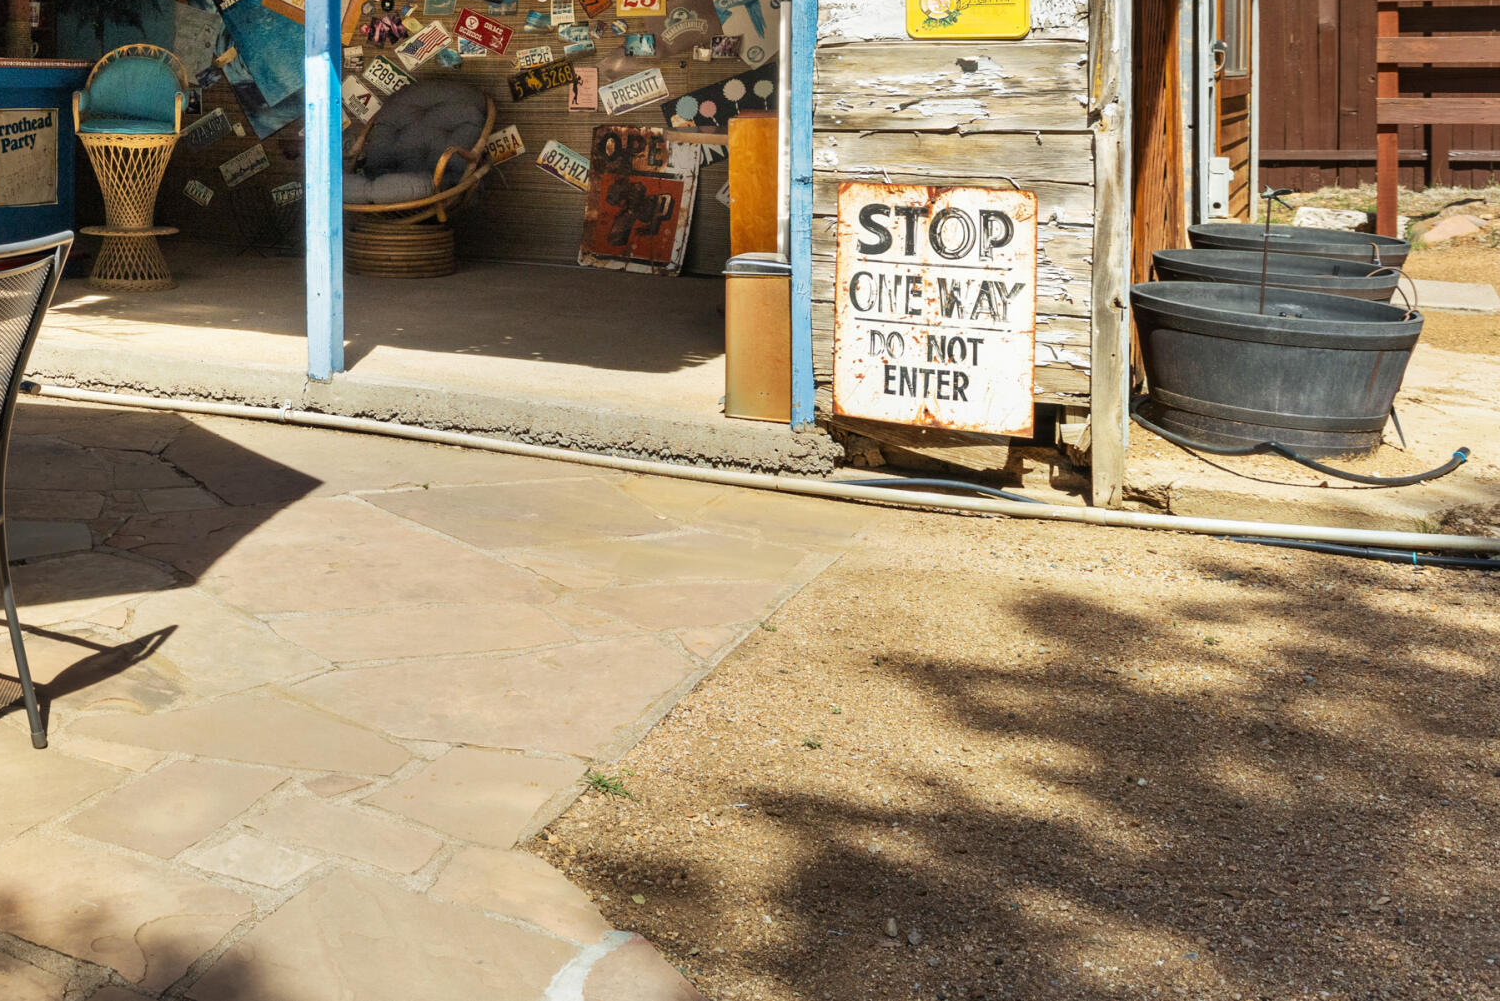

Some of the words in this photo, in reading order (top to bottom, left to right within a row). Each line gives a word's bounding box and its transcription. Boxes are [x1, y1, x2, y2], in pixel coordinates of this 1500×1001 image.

[611, 75, 660, 105] PRESKITT
[0, 133, 37, 154] Party
[599, 132, 664, 169] OPE
[856, 202, 1015, 262] STOP
[849, 270, 923, 316] ONE
[936, 276, 1027, 323] WAY
[869, 328, 905, 360] DO
[926, 334, 985, 367] NOT
[883, 364, 970, 403] ENTER
